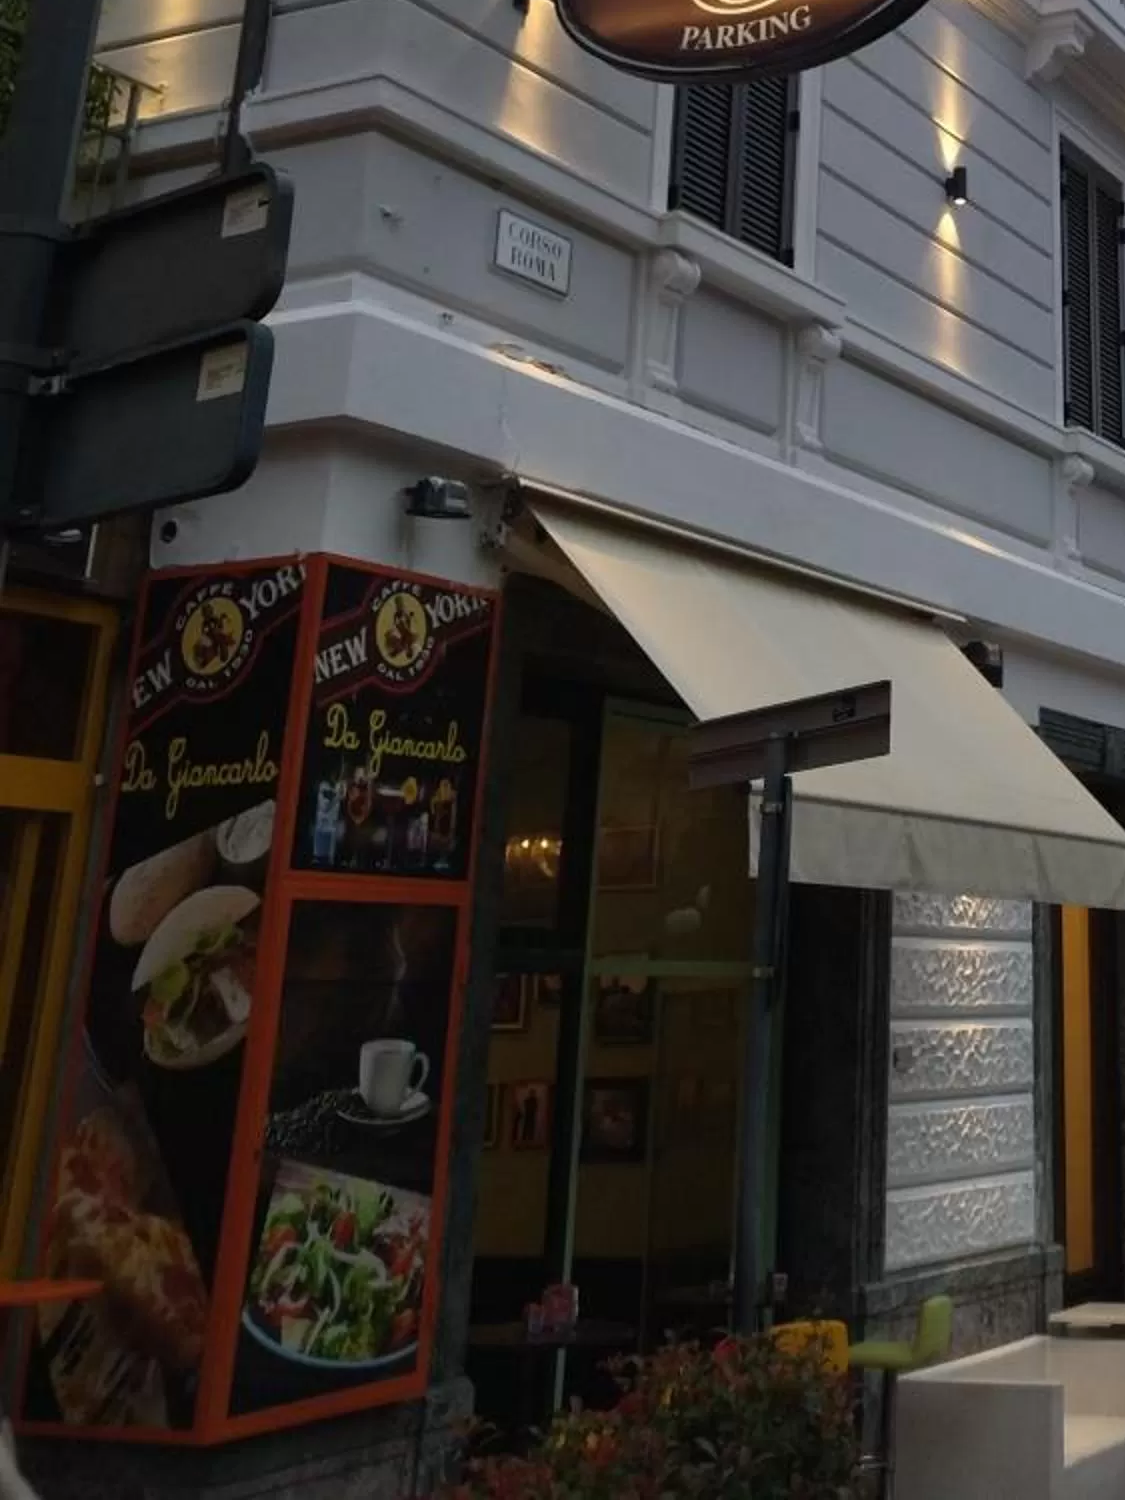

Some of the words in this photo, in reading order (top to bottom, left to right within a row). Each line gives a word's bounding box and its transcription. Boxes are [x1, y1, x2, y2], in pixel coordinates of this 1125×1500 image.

[679, 5, 812, 51] PARKING
[511, 245, 556, 282] ROMA
[131, 647, 172, 708] EW
[314, 626, 368, 684] NEW
[323, 703, 360, 750] Da
[368, 709, 468, 779] Giancarlo
[121, 740, 156, 792] Da
[165, 730, 280, 821] Giancarlo
